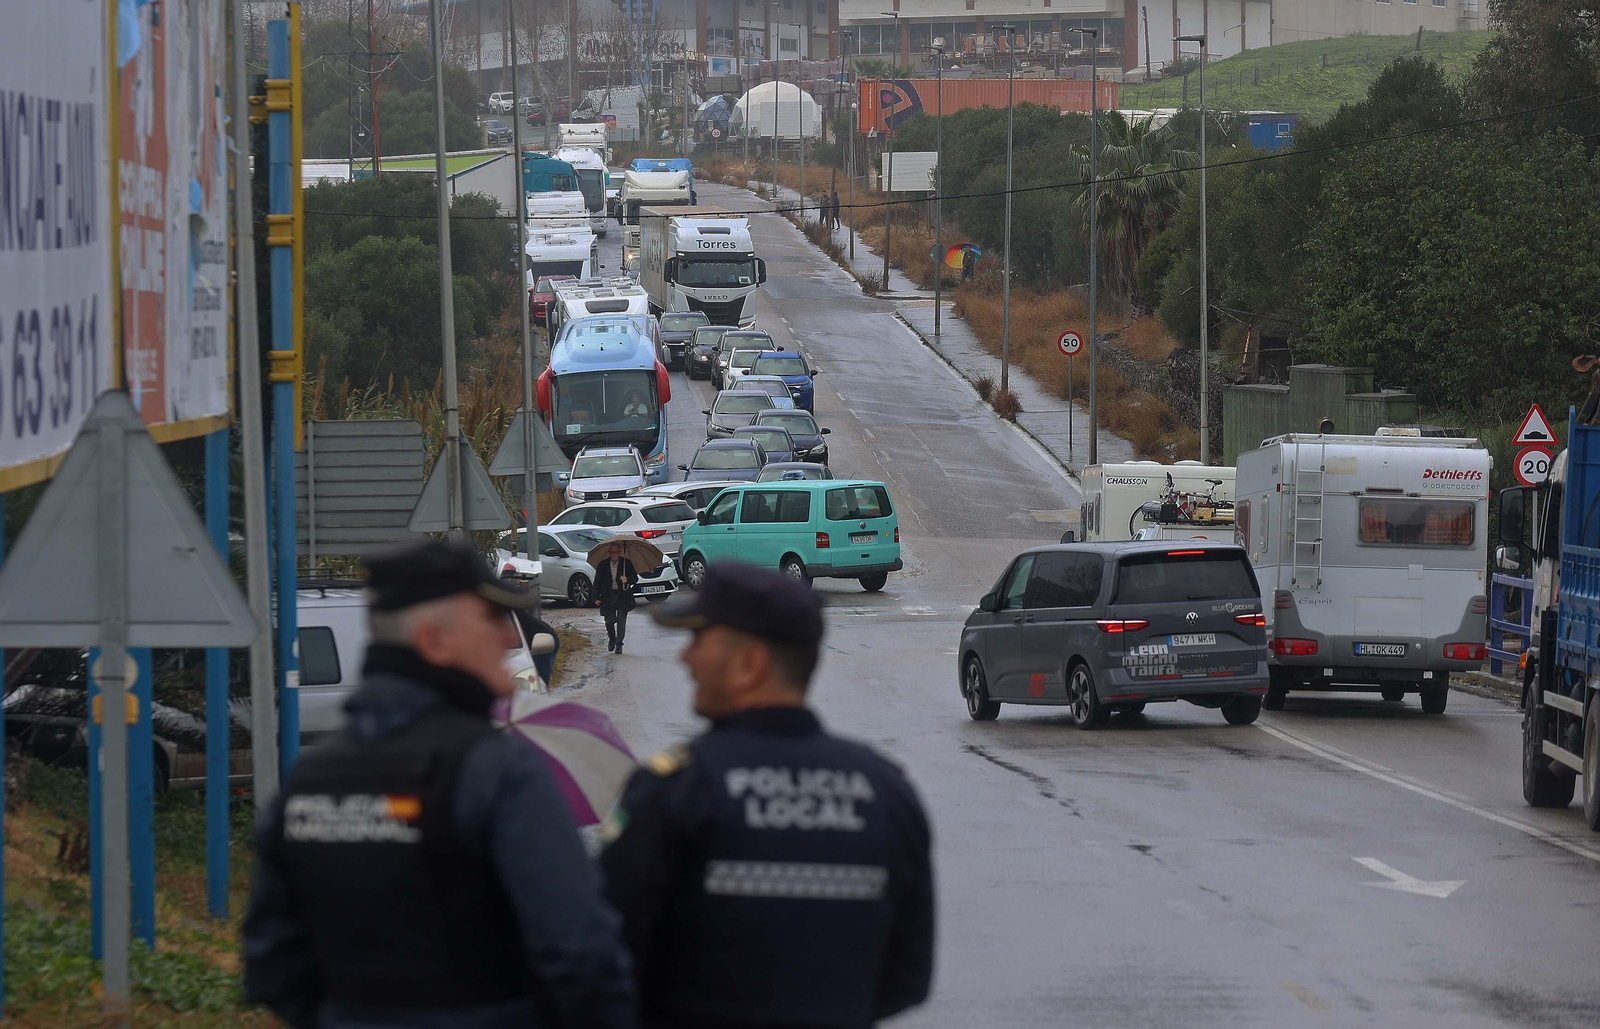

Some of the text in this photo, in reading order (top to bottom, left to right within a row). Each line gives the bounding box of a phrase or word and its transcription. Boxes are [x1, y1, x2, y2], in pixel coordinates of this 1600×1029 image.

[696, 239, 737, 250] Torres
[1063, 338, 1078, 347] 50
[12, 308, 43, 438] 63
[50, 303, 72, 429] 39
[1523, 459, 1548, 474] 20
[1422, 468, 1483, 480] Dethleffs
[1106, 477, 1148, 485] CHAUSSON
[1421, 482, 1482, 490] Globetrotter
[1173, 635, 1195, 645] 9471
[1130, 644, 1169, 656] Leon
[1360, 645, 1371, 654] HL
[1388, 645, 1404, 655] 449
[1127, 664, 1175, 677] Tarifa
[1175, 667, 1207, 675] Escuela
[725, 767, 875, 802] POLICIA
[745, 796, 866, 831] LOCAL
